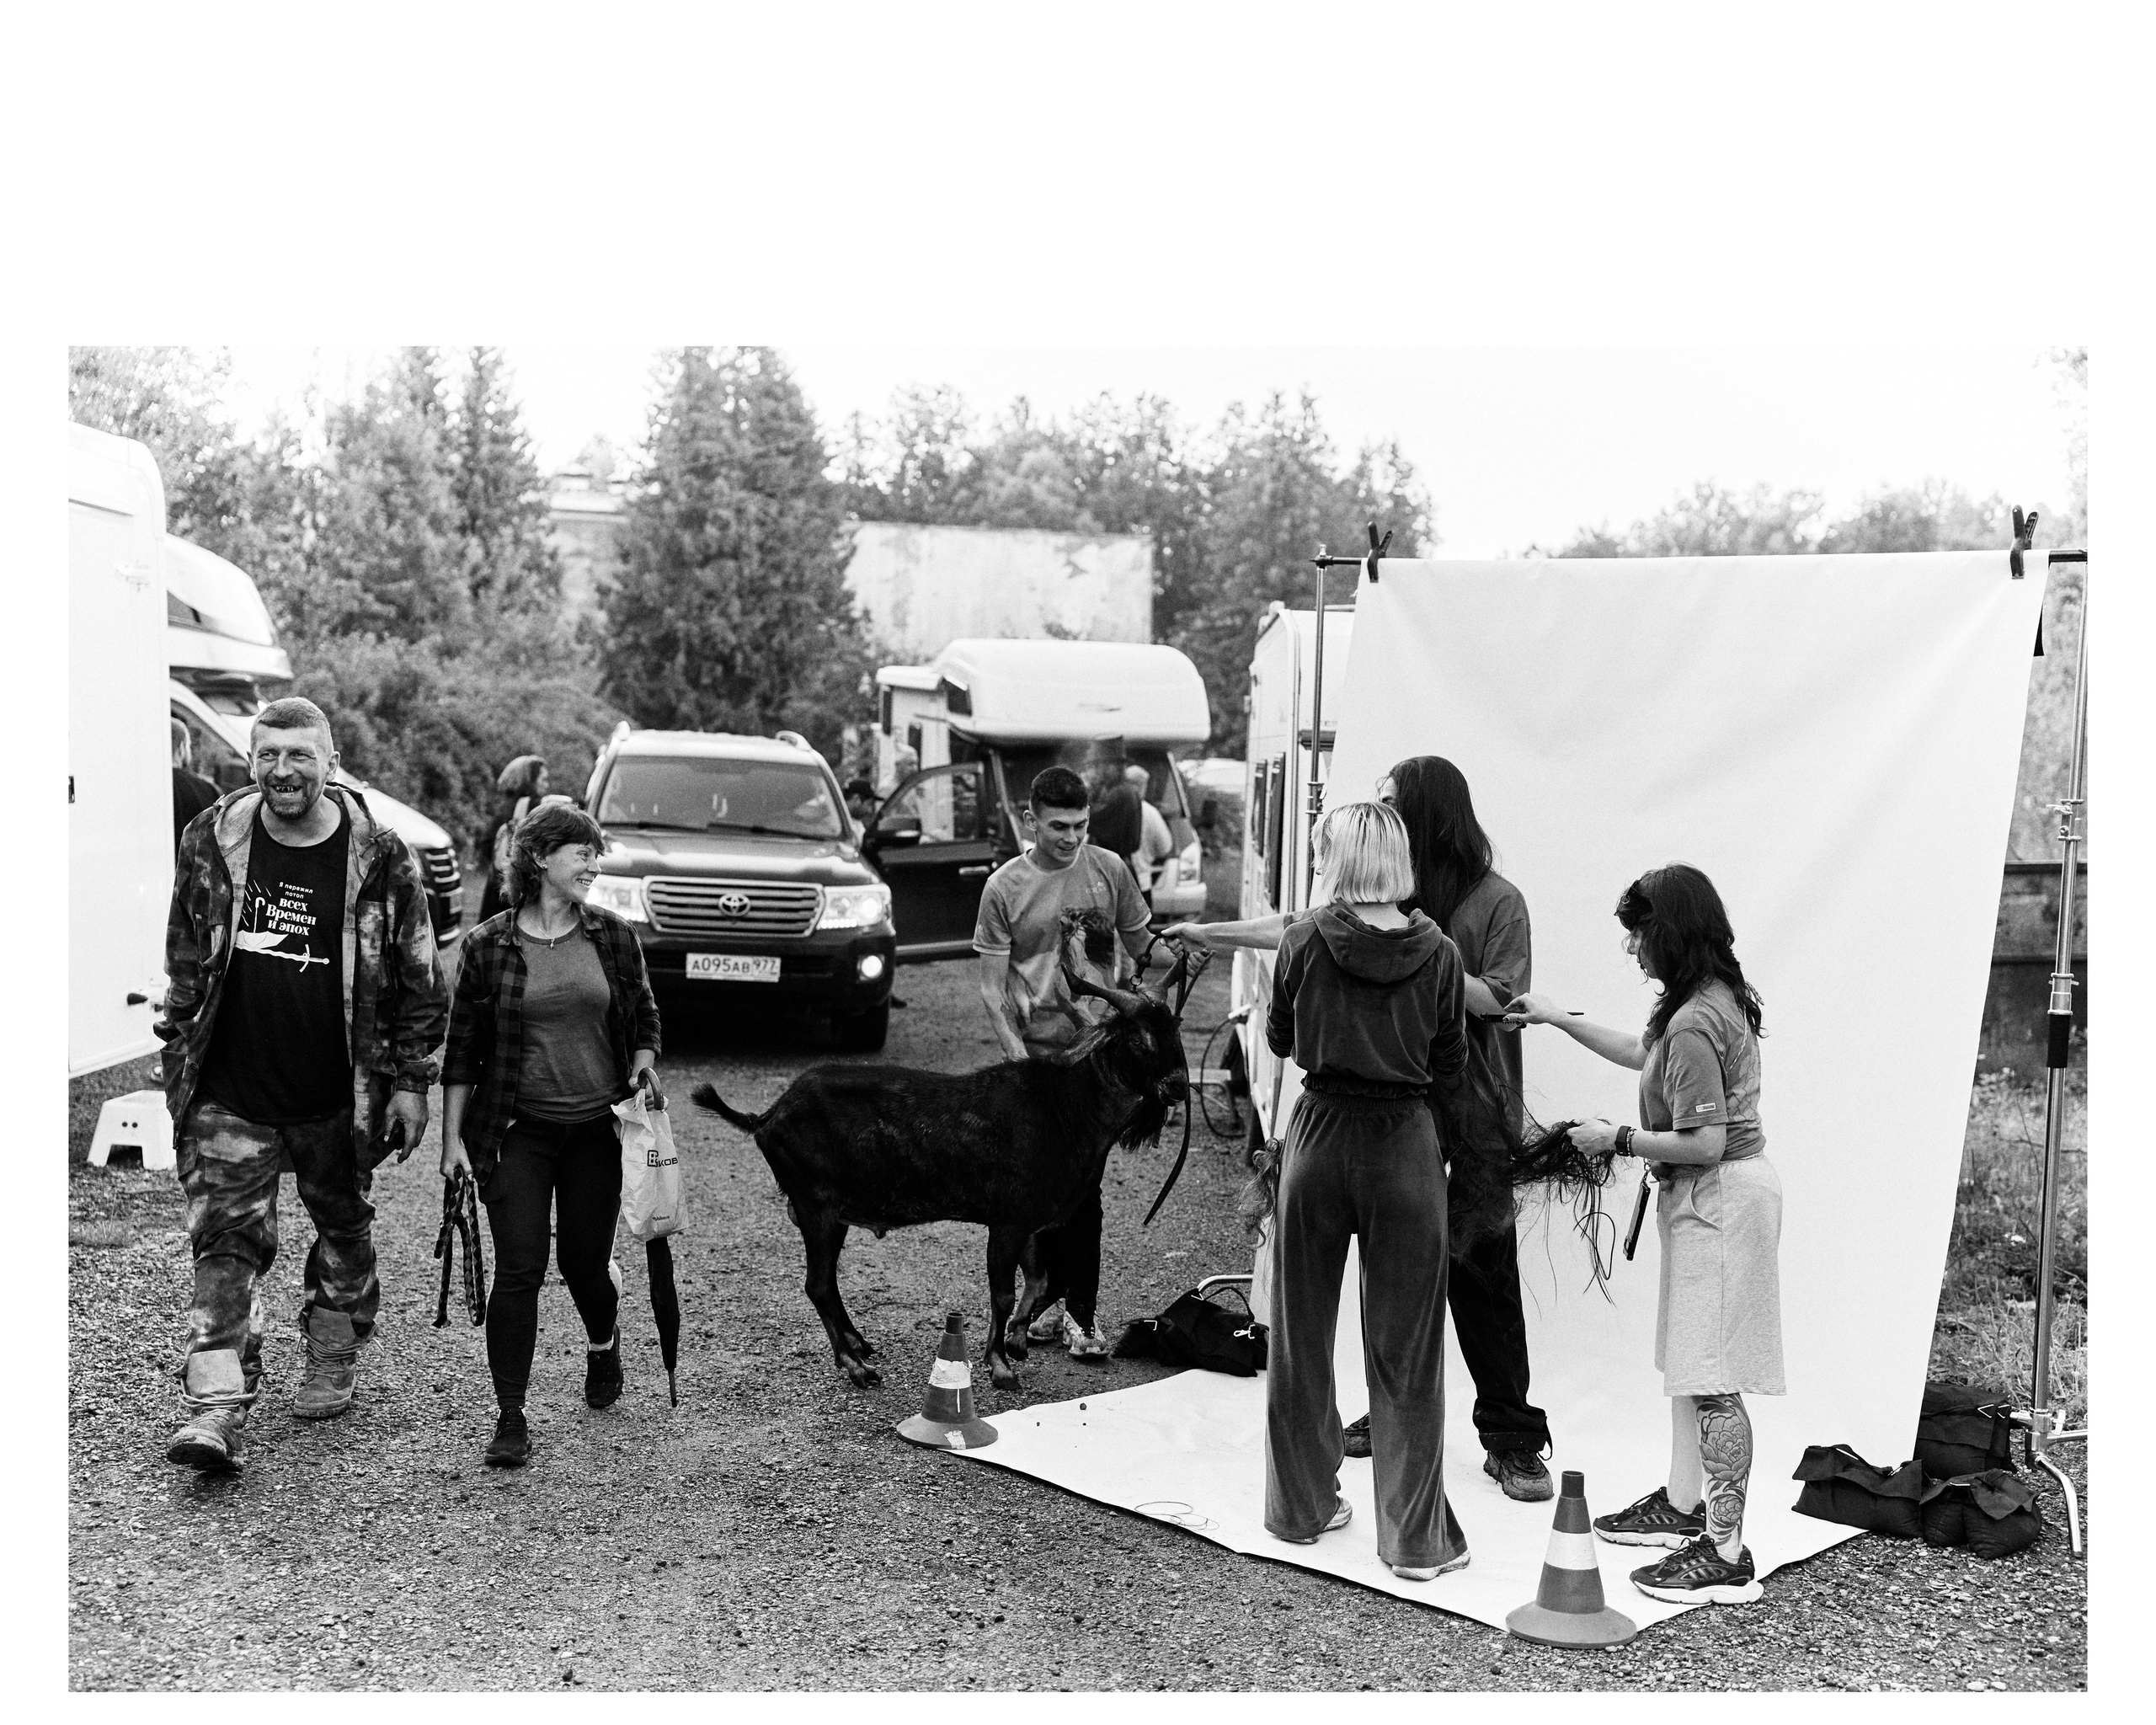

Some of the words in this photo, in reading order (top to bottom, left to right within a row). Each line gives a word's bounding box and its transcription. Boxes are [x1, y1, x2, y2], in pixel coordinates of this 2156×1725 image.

[284, 884, 313, 894] пережил
[279, 898, 308, 912] всех
[265, 904, 317, 926] Времен
[278, 921, 310, 936] эпох
